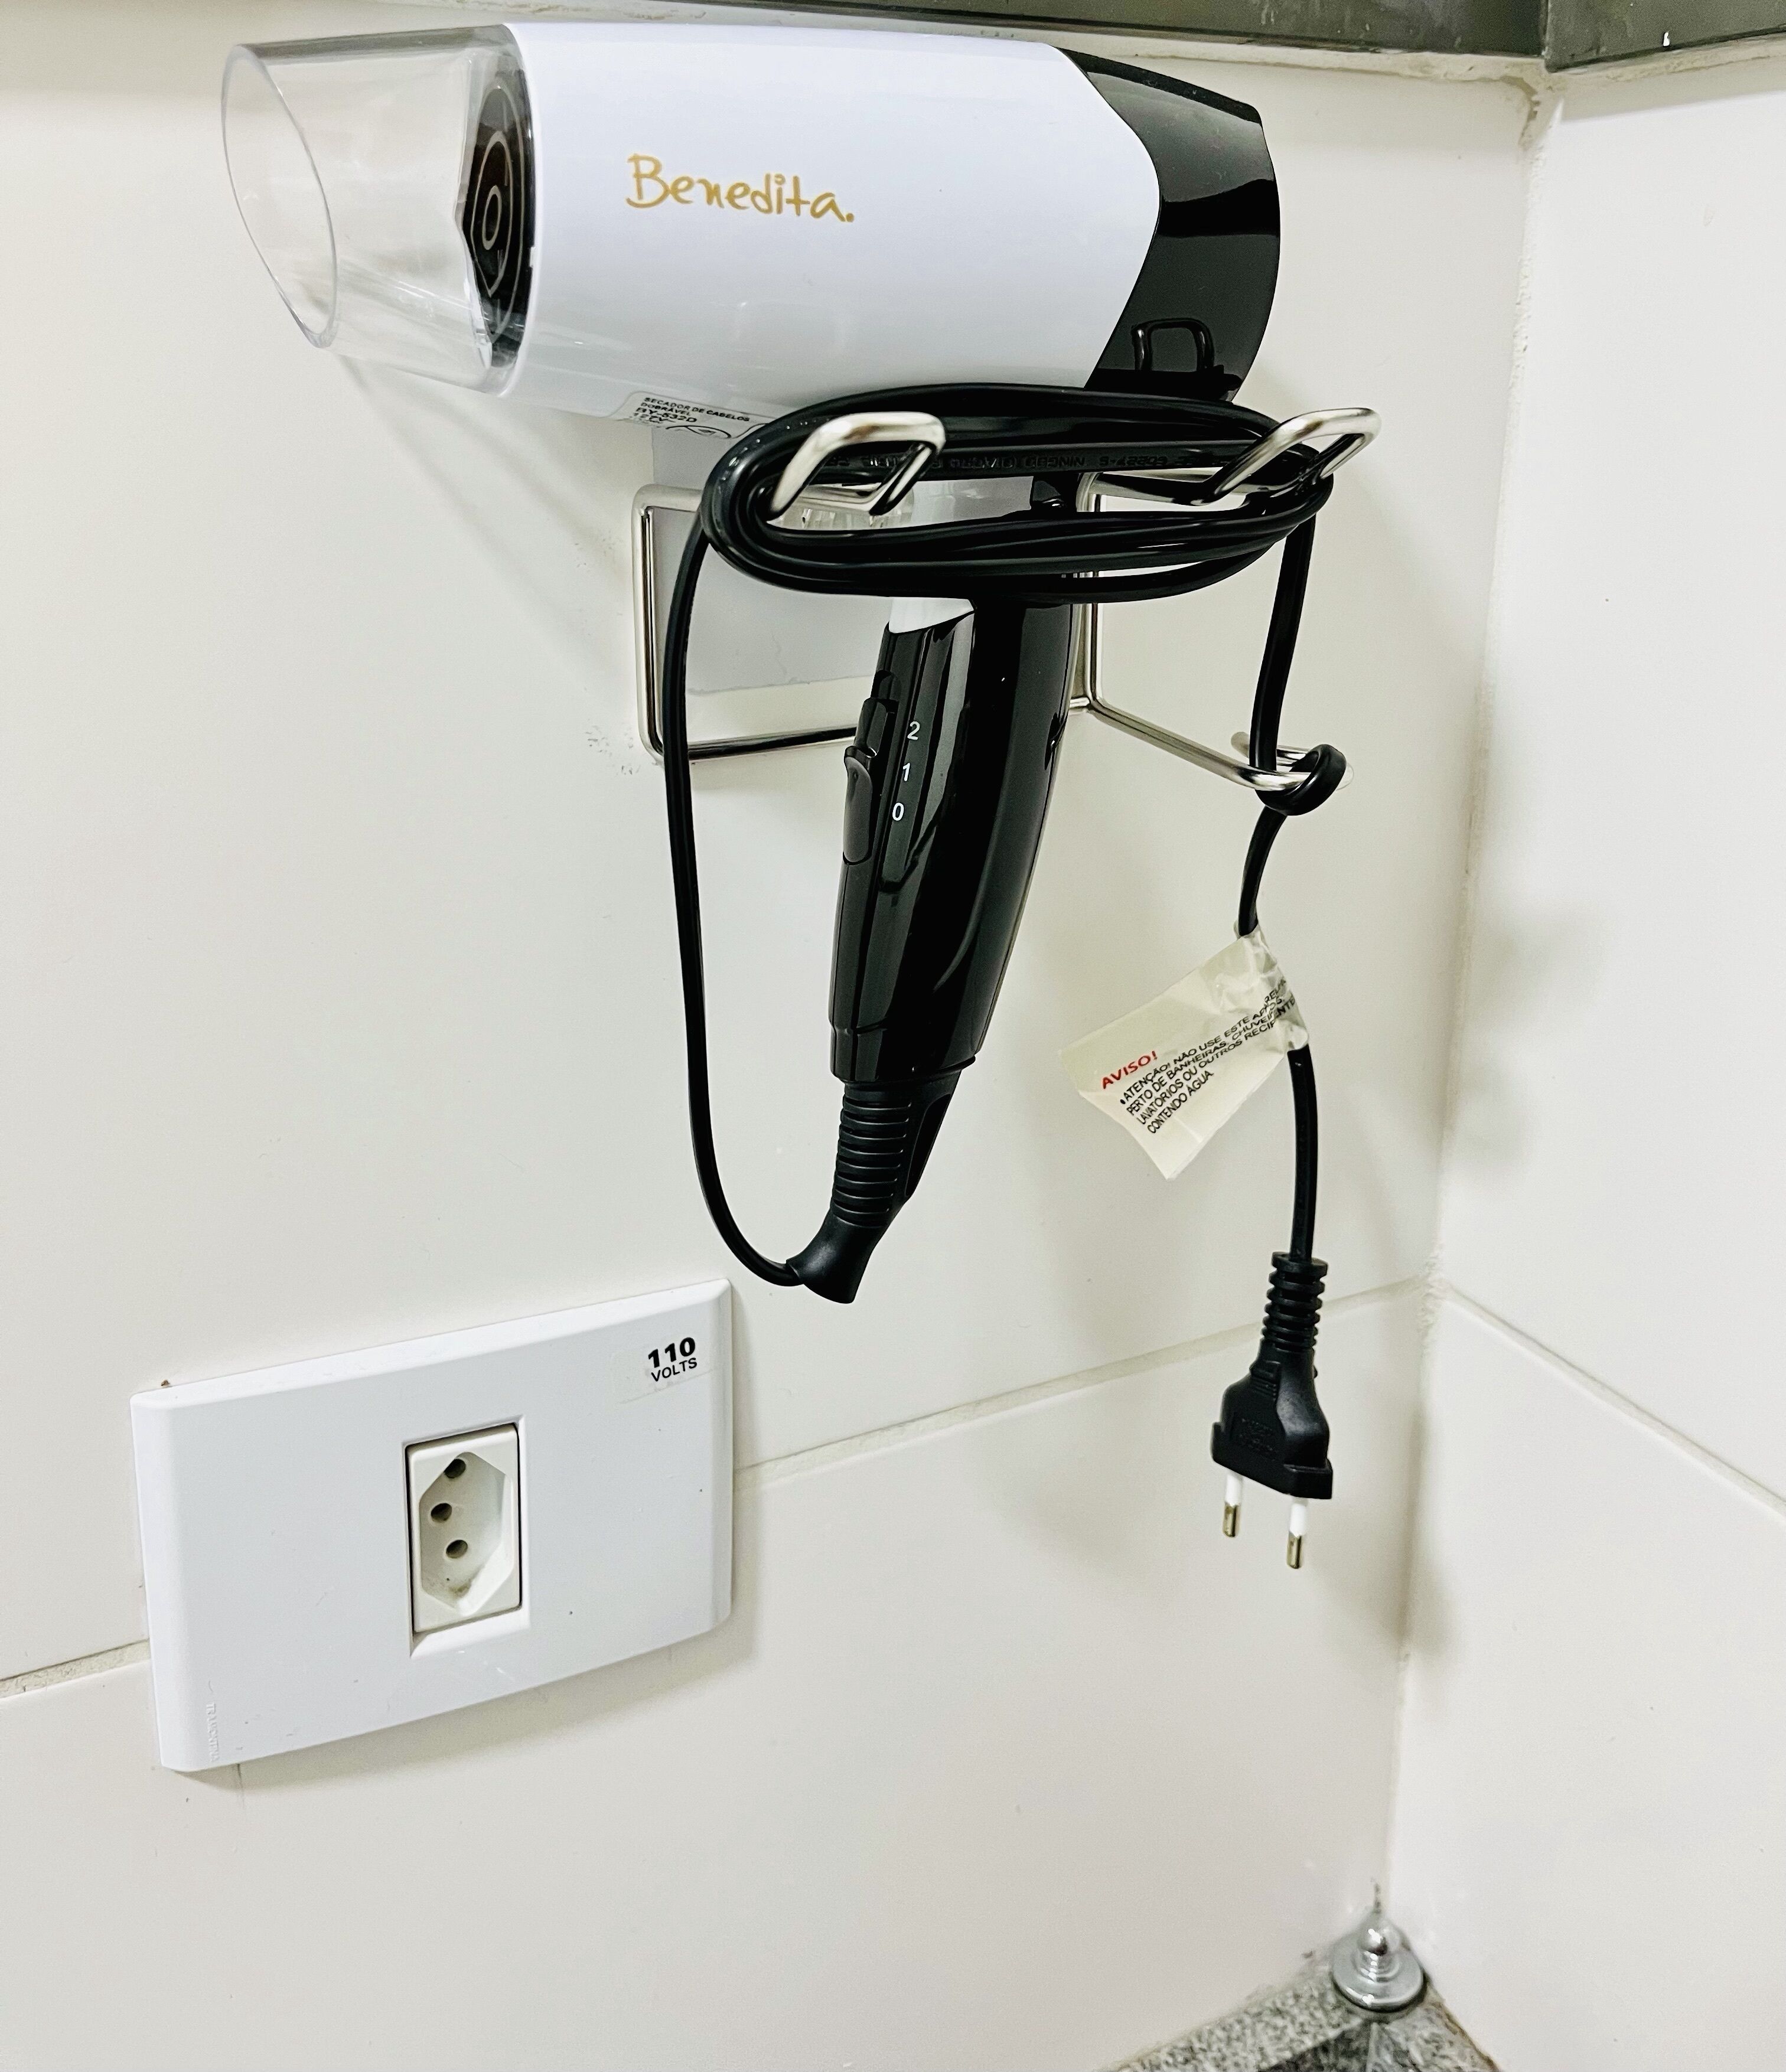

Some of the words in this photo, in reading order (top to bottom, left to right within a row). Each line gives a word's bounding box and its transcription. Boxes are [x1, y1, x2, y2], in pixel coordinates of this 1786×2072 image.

[644, 397, 691, 410] SECADOR
[706, 409, 750, 422] CABELOS
[907, 721, 920, 740] 2
[902, 762, 911, 782] 1
[892, 802, 904, 821] 0
[1174, 1048, 1197, 1064] NÃO
[1199, 1035, 1221, 1051] USE
[1224, 1016, 1250, 1037] ESTE
[1102, 1050, 1158, 1089] AVISO!
[1182, 1066, 1197, 1081] OU
[1199, 1039, 1243, 1068] OUTROS
[1126, 1089, 1152, 1115] PERTO
[1152, 1076, 1168, 1092] DE
[1147, 1092, 1188, 1134] CONTENDO
[648, 1337, 696, 1368] 110
[651, 1358, 698, 1382] VOLTS
